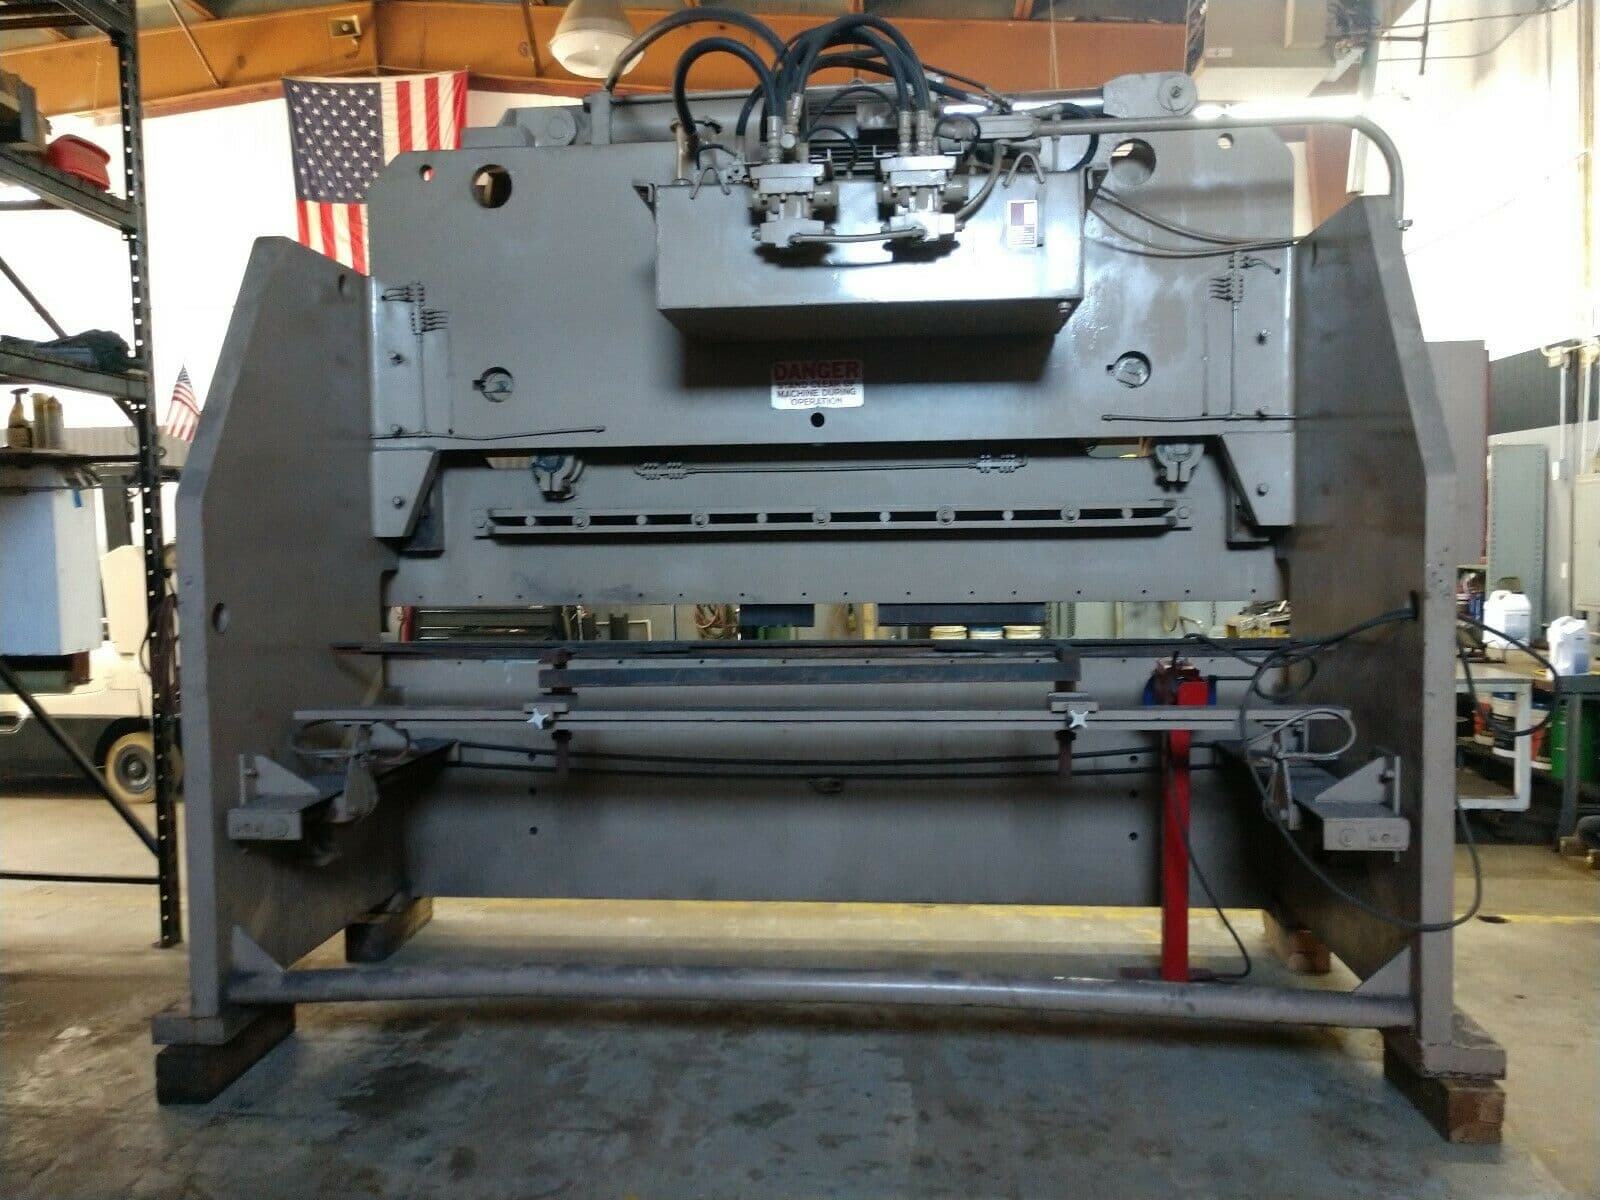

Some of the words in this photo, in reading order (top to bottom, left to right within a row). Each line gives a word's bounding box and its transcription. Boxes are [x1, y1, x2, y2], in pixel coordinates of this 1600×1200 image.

[774, 361, 859, 379] DANGER
[777, 389, 819, 398] MACHINE
[822, 387, 856, 397] DURING
[791, 397, 843, 406] OPERATION
